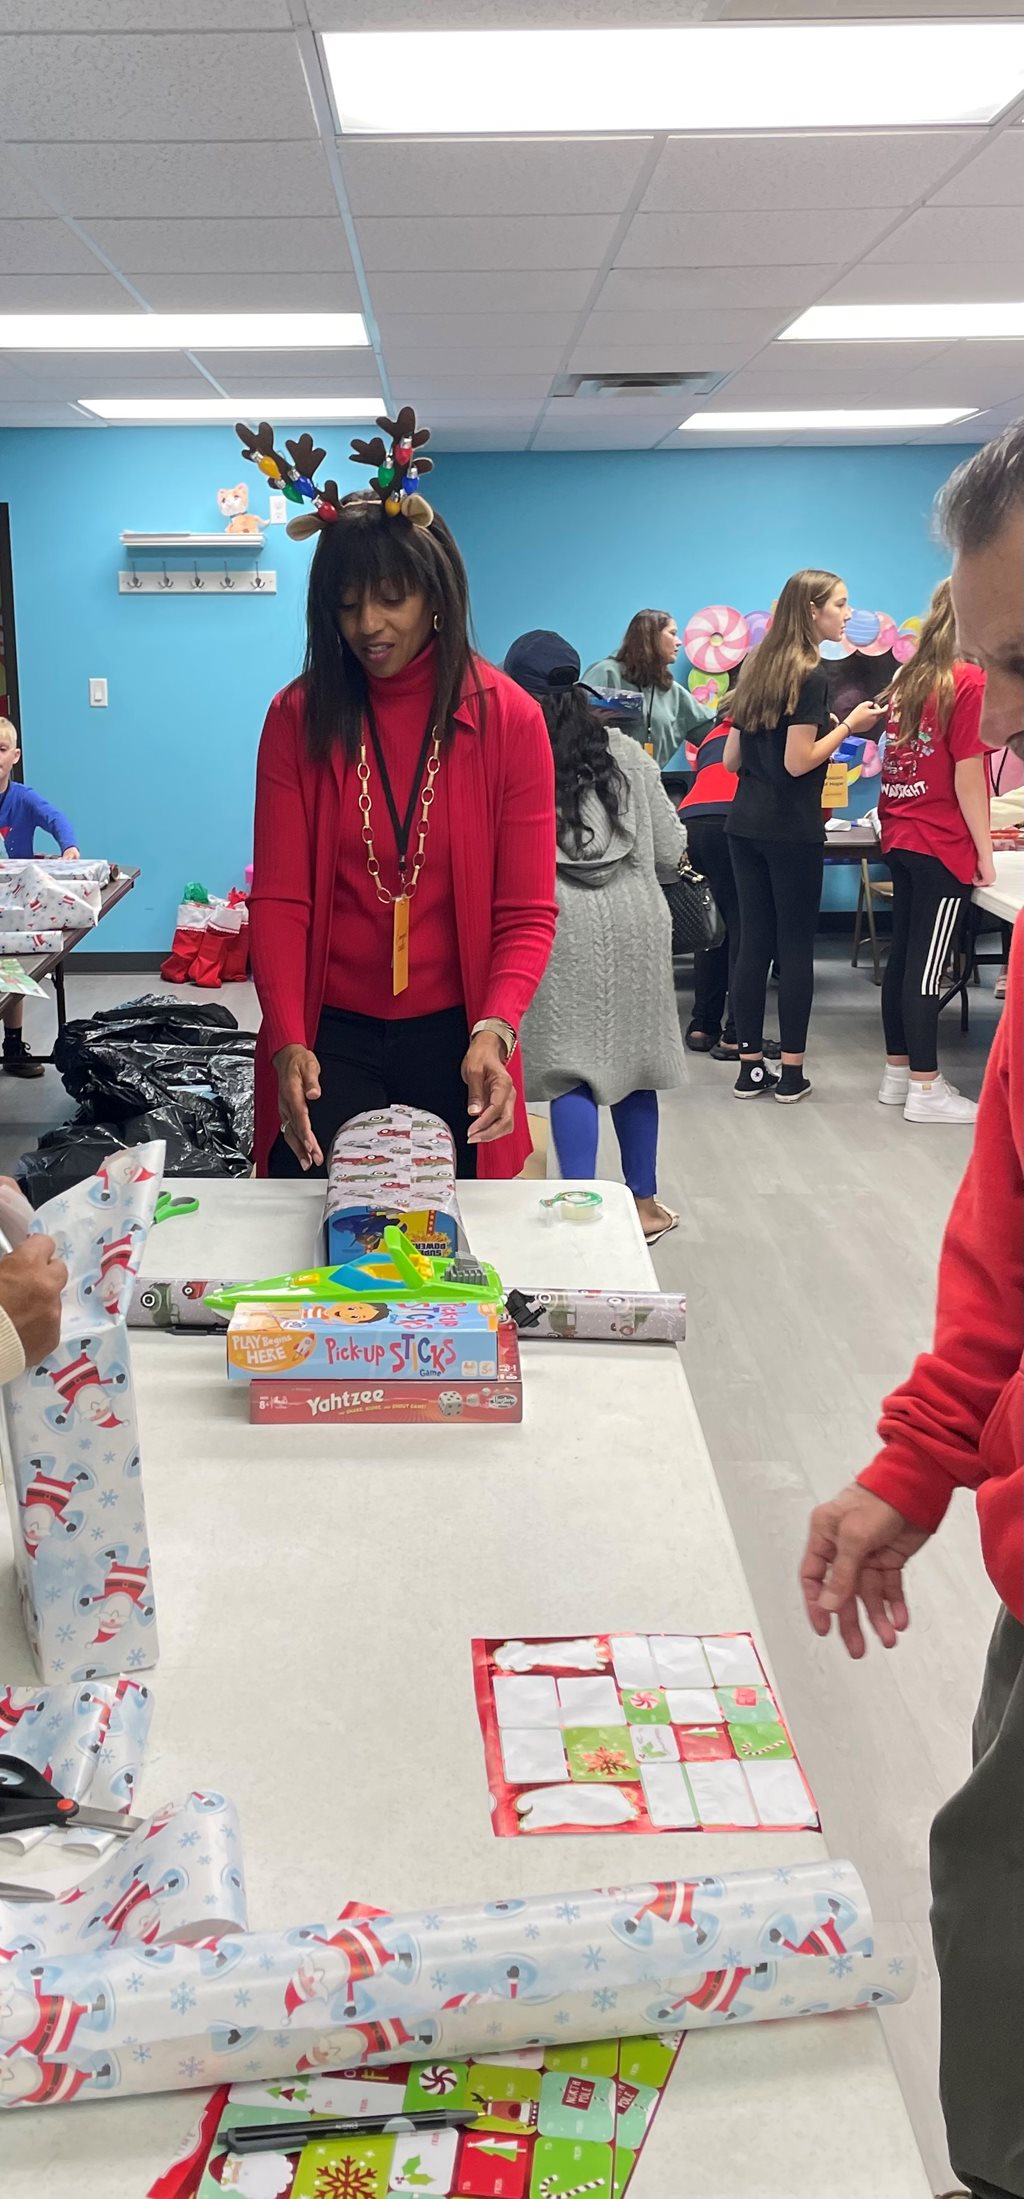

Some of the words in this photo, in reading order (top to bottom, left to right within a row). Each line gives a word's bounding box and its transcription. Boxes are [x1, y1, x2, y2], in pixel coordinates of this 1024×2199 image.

[232, 1335, 261, 1350] PLAY
[262, 1335, 292, 1347] Begins
[247, 1347, 287, 1364] HERE
[324, 1336, 385, 1368] Pick-up
[389, 1334, 457, 1374] STICKS
[419, 1368, 442, 1378] Game
[306, 1389, 385, 1416] Yahtzee
[564, 2080, 582, 2104] NORTH
[578, 2086, 593, 2105] POLE
[617, 2091, 635, 2109] POLE
